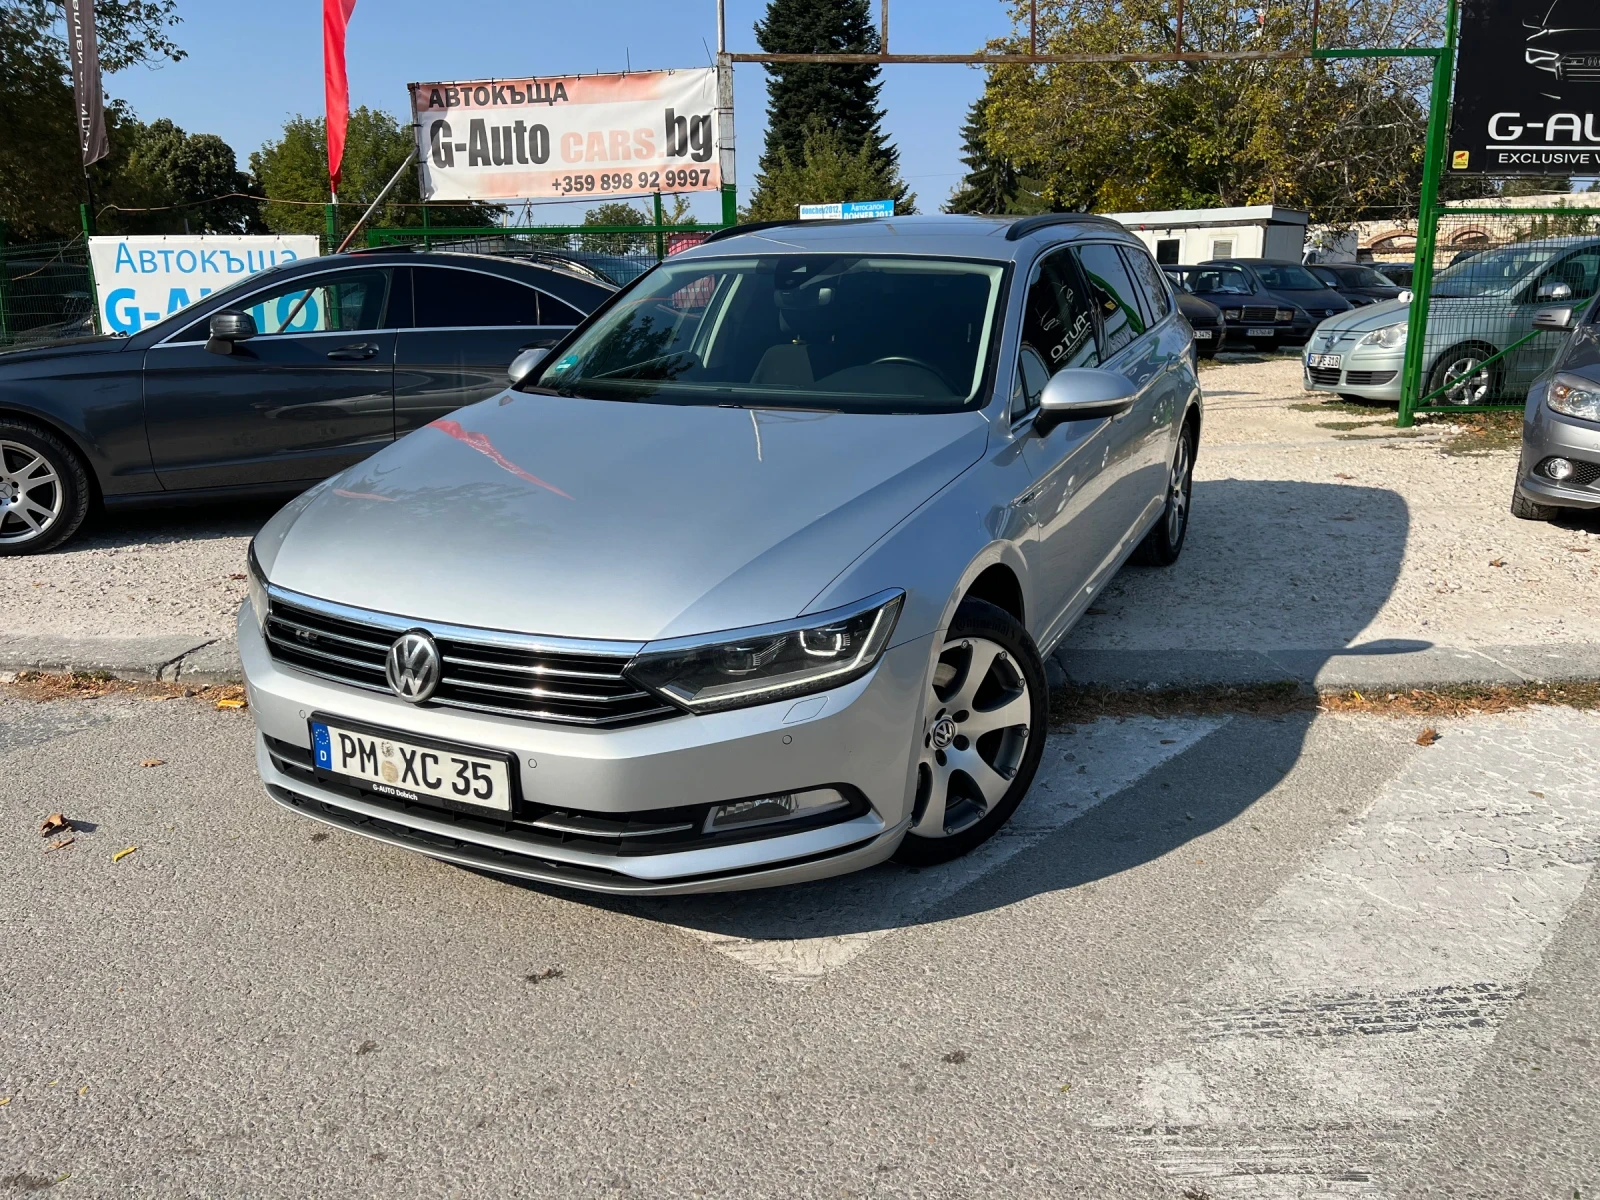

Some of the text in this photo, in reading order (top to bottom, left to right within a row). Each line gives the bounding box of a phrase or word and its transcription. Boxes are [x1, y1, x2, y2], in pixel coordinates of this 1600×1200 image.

[428, 82, 569, 109] АВТОКЪЩА
[430, 118, 550, 168] G-Auto
[1498, 153, 1590, 164] EXCLUSIVE
[552, 169, 710, 193] +359 898 92 9997
[851, 203, 885, 212] Автосалон
[105, 287, 318, 335] G-AO
[319, 732, 493, 800] D PM XC 35
[372, 783, 418, 801] G-AUTO Dobrich
